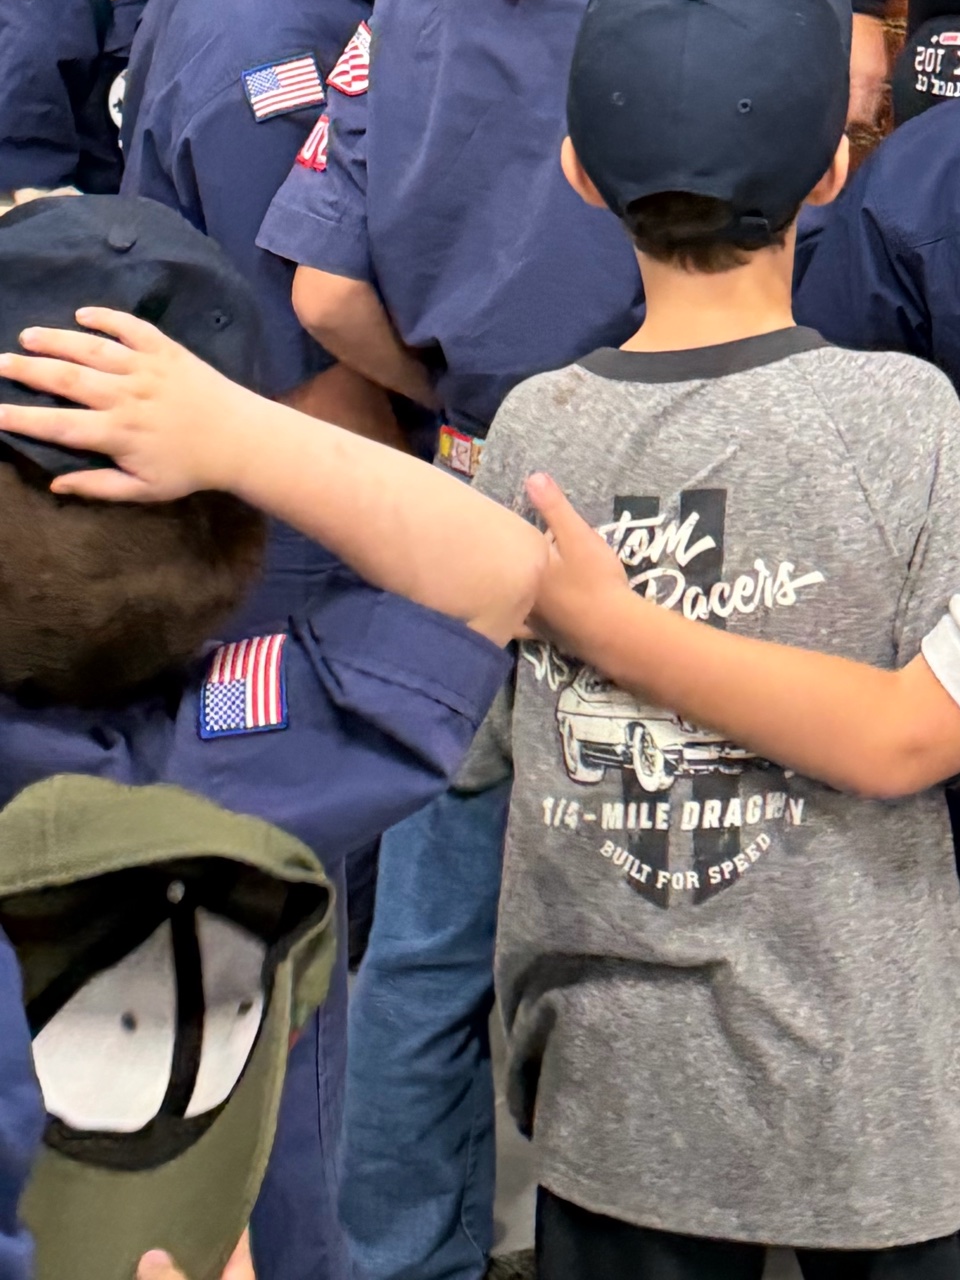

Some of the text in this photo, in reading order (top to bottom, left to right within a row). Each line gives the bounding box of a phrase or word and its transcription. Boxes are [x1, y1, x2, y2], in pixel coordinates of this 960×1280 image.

[914, 46, 946, 74] 102
[598, 510, 717, 568] tom
[600, 832, 772, 890] BUILT FOR SPEED
